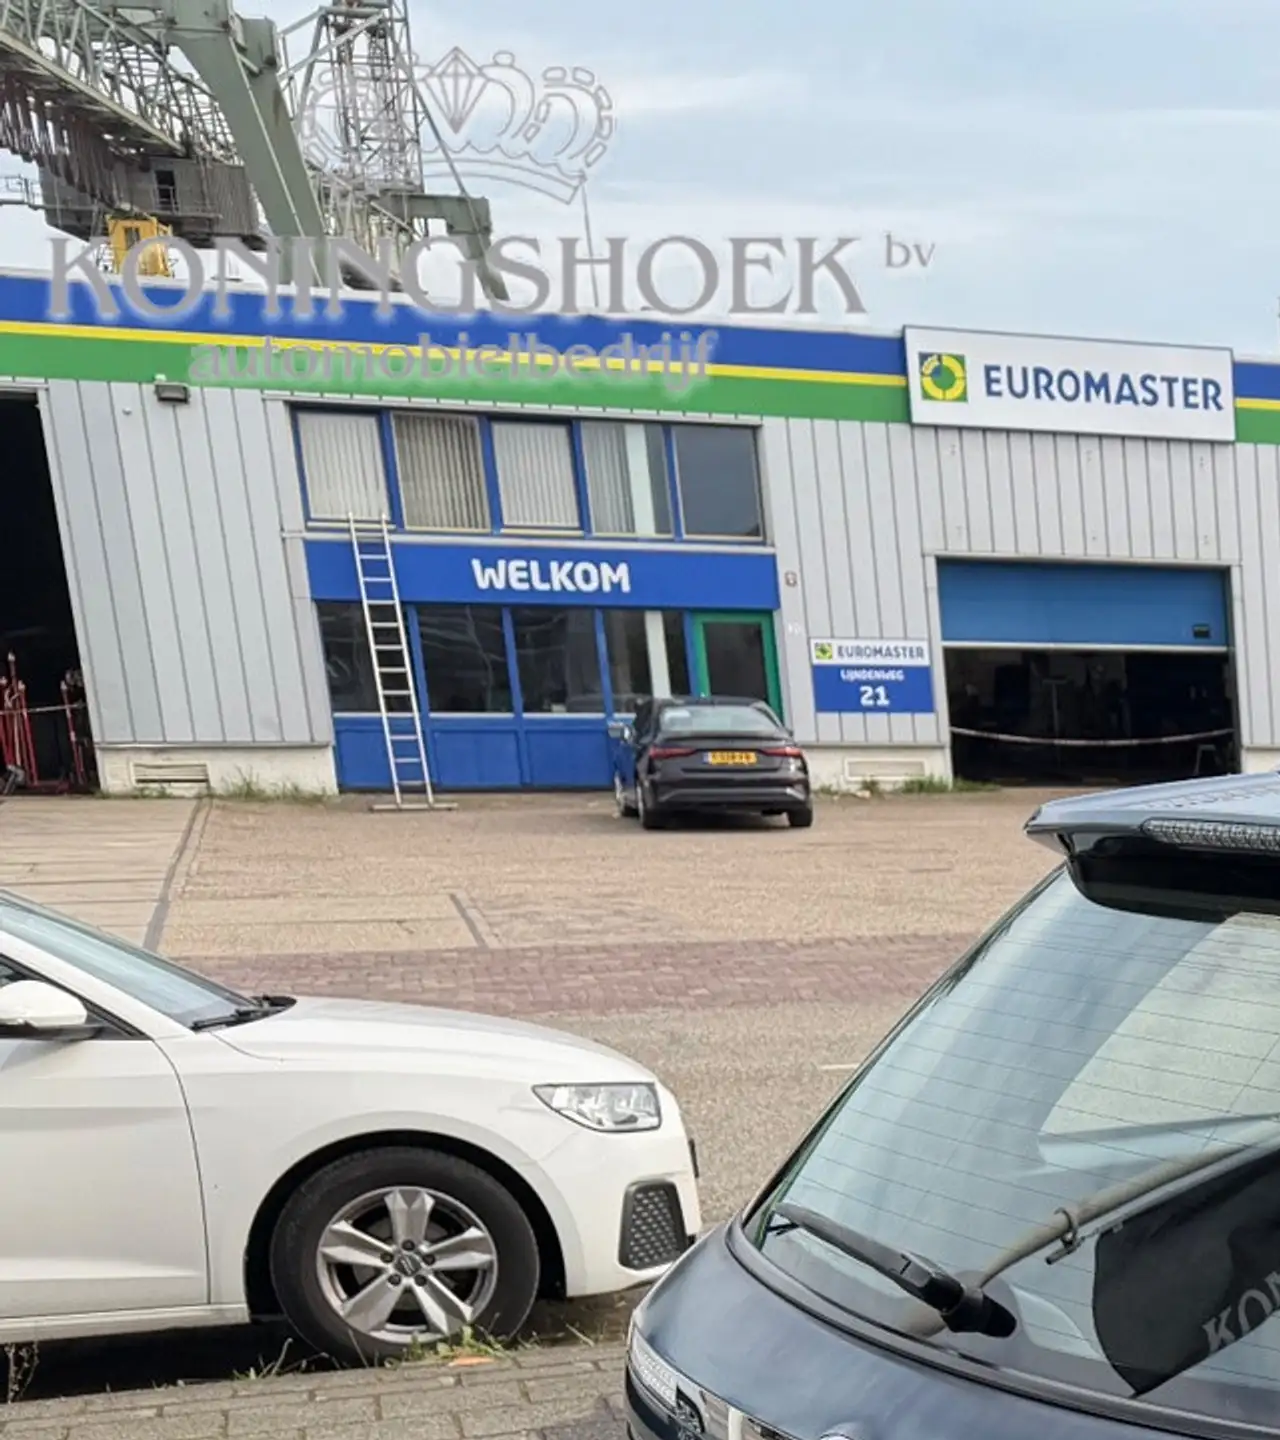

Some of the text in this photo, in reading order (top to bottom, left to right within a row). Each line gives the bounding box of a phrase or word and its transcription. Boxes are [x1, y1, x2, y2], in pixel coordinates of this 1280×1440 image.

[984, 363, 1224, 411] EUROMASTER
[471, 558, 631, 593] WELKOM
[837, 645, 924, 659] EUROMASTER
[860, 685, 890, 706] 21
